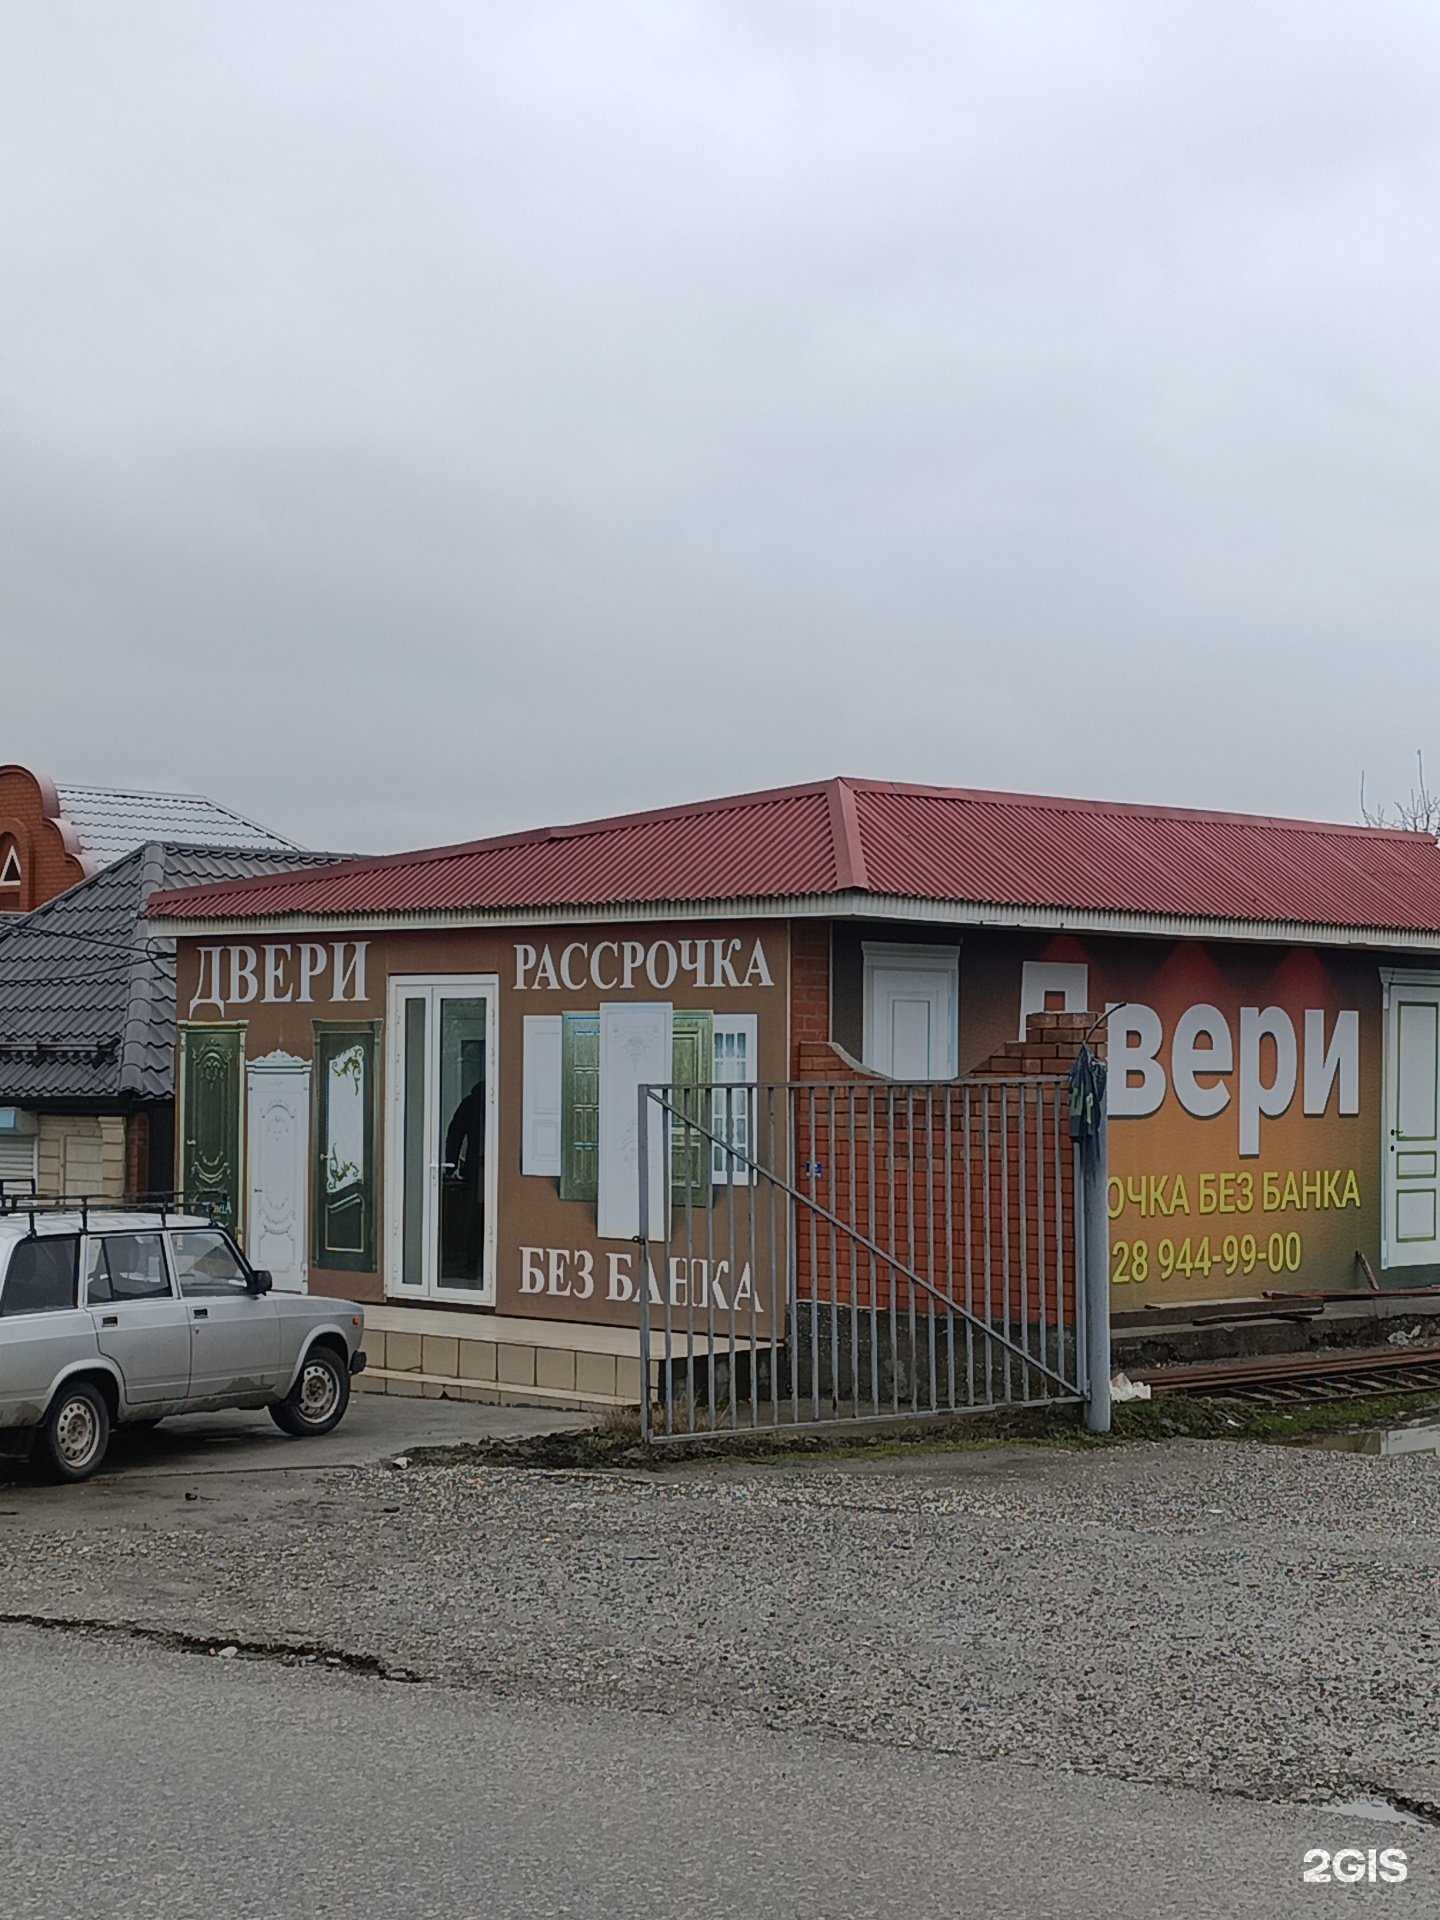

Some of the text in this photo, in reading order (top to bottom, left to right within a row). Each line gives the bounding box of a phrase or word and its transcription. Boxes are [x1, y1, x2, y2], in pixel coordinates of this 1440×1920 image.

[189, 941, 372, 1020] ДВЕРИ
[512, 937, 775, 991] РАССРОЧКА
[1199, 1171, 1254, 1214] БЕЗ
[1263, 1169, 1361, 1212] БАНКА
[518, 1246, 764, 1313] БЕЗ БАНКА
[1112, 1231, 1301, 1284] 28 944-99-00
